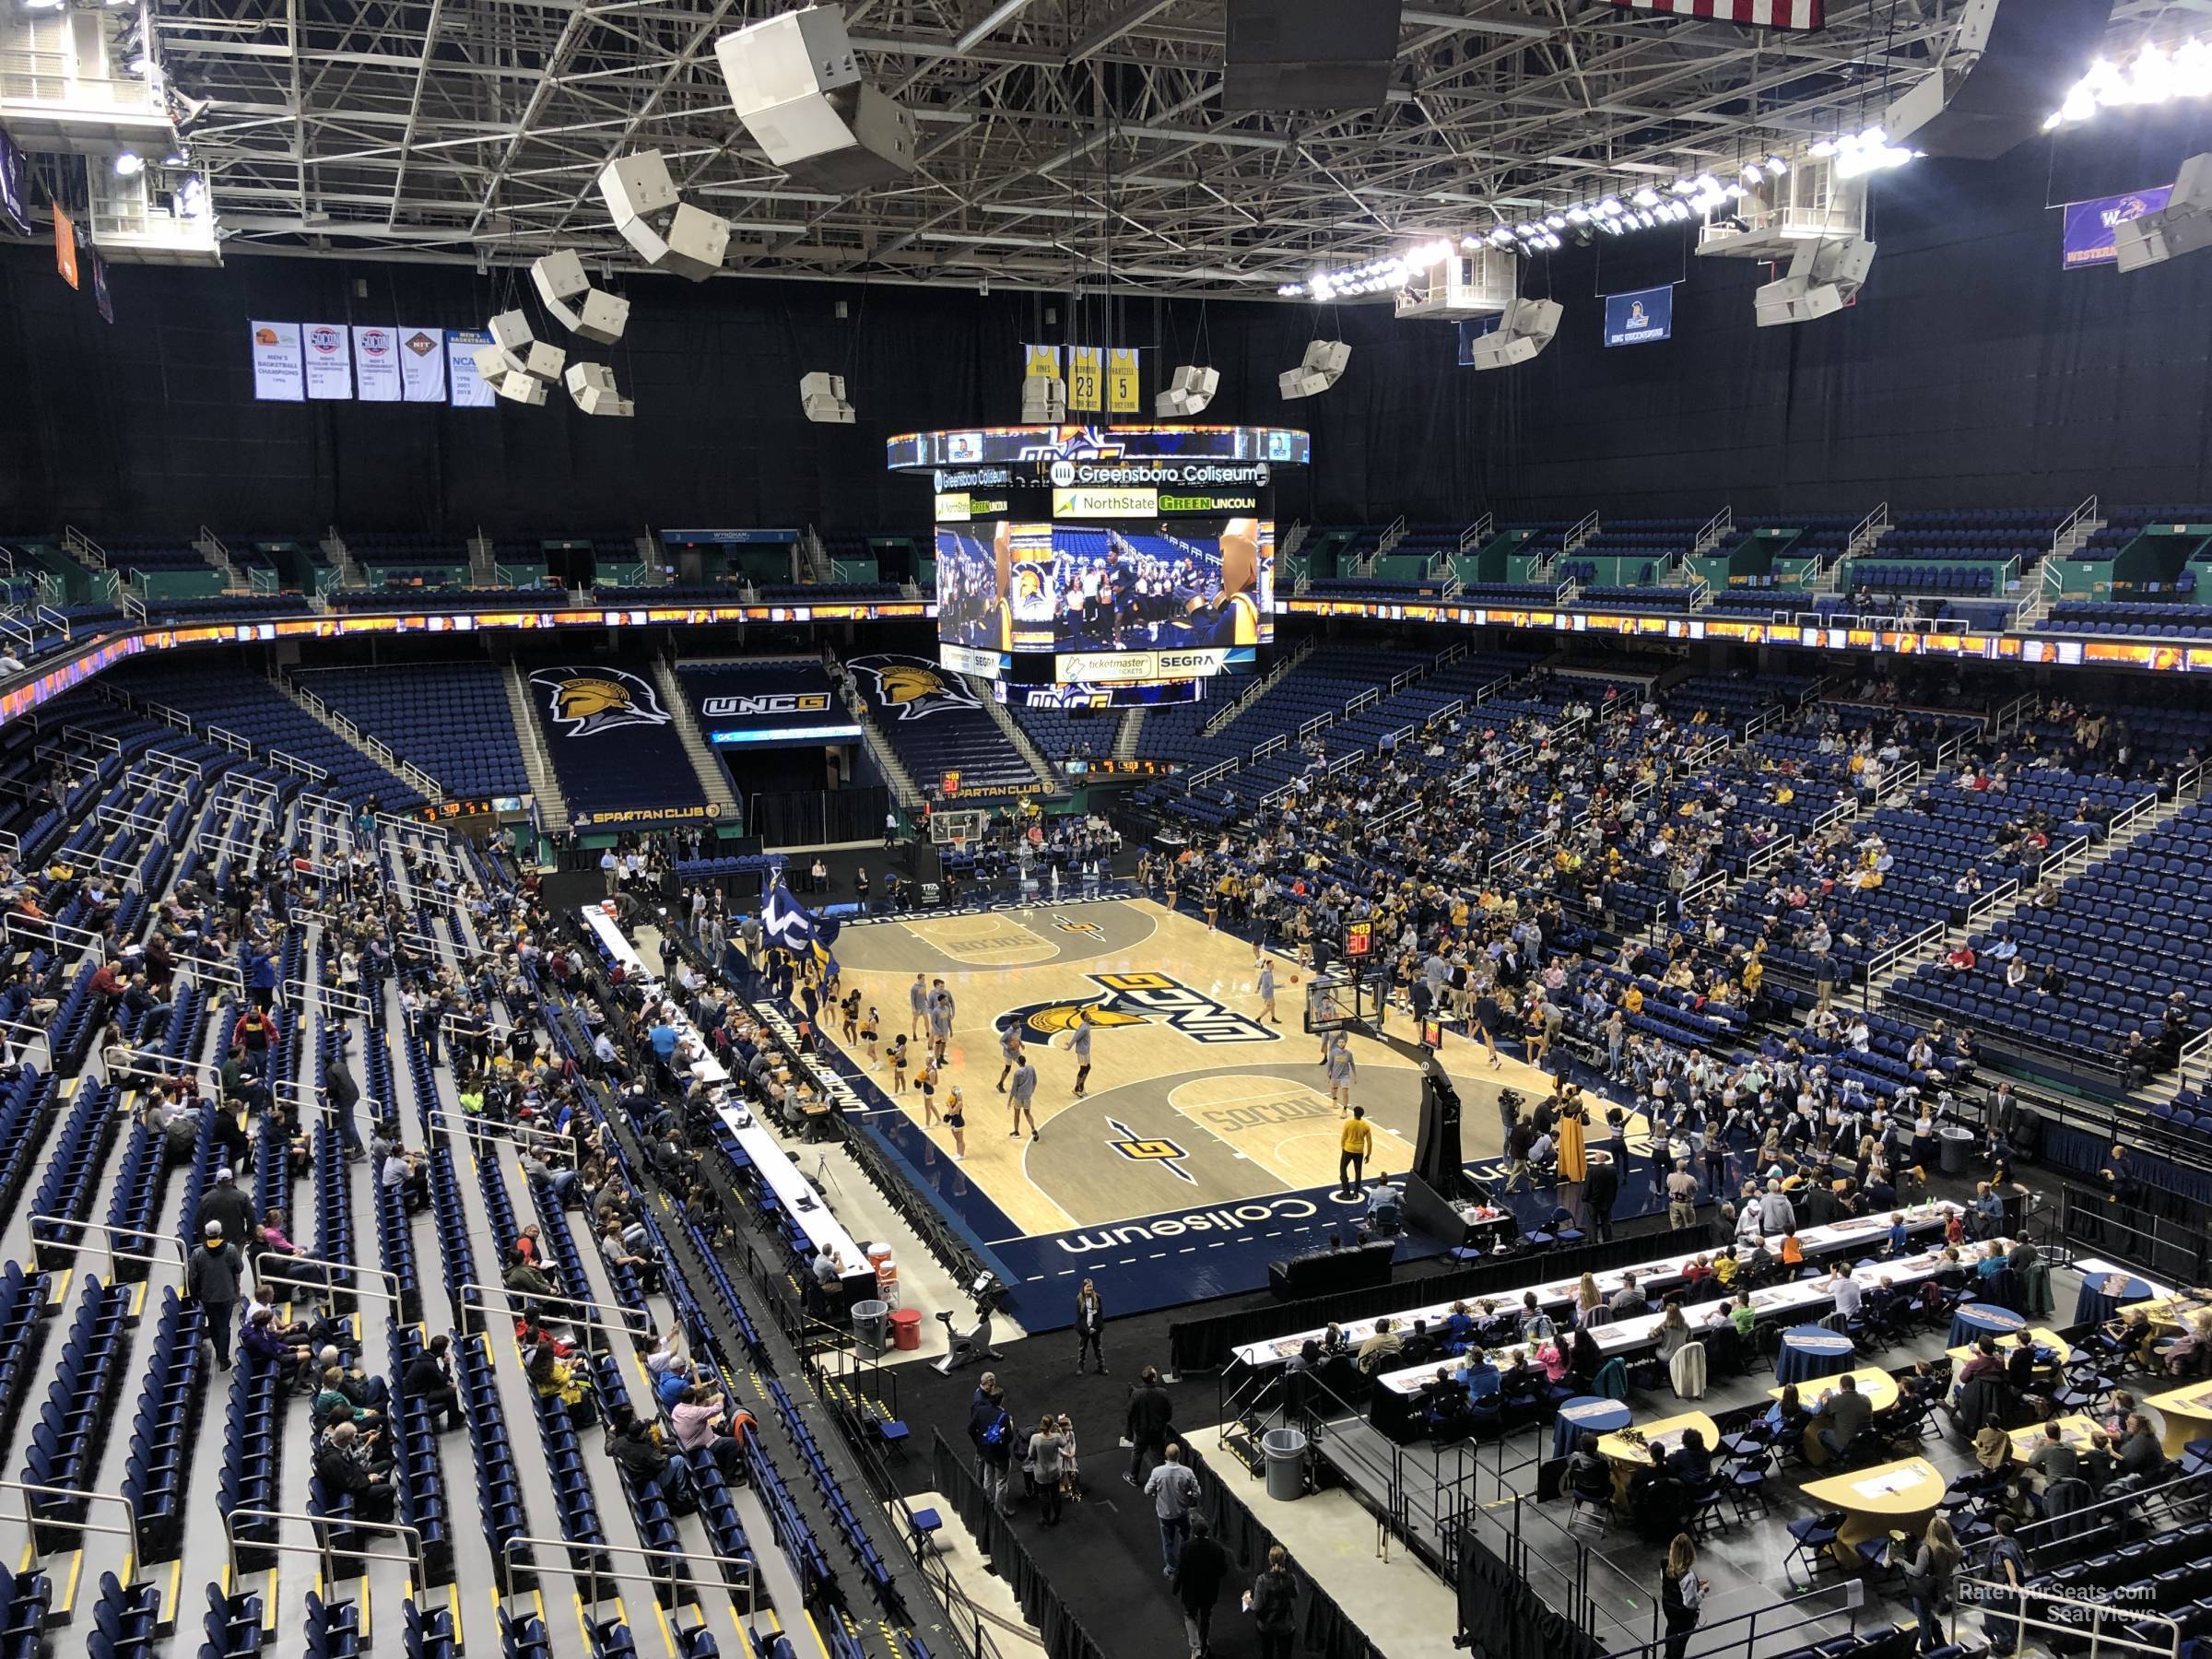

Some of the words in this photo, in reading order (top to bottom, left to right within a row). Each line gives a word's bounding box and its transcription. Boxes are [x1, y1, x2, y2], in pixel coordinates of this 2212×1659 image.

[453, 357, 477, 366] NCA
[1119, 378, 1127, 398] 5
[943, 471, 977, 488] Greensboro
[979, 469, 1007, 485] Coliseum
[1079, 464, 1178, 483] Greensboro
[1184, 464, 1257, 482] Coliseum
[1084, 496, 1155, 510] NorthState
[1211, 498, 1255, 510] LINCOLN
[1088, 658, 1147, 670] ticketmaster
[1160, 655, 1215, 668] SEGRA
[706, 694, 828, 714] UNCG
[944, 780, 958, 792] 30
[950, 785, 1006, 799] PARTAN
[1007, 783, 1041, 794] CLUB
[443, 803, 460, 813] 4:03
[593, 809, 663, 824] SPARTAN
[665, 806, 704, 819] CLUB
[921, 883, 939, 891] TFA
[840, 907, 982, 928] eensboro
[991, 894, 1132, 912] Coliseum
[1350, 924, 1371, 935] 4:03
[946, 935, 1039, 953] SOCON
[1348, 935, 1368, 954] 30
[1094, 971, 1279, 1042] UNCG
[518, 1036, 528, 1045] 20
[1201, 1096, 1329, 1133] SOCON
[1056, 1199, 1317, 1253] Coliseum
